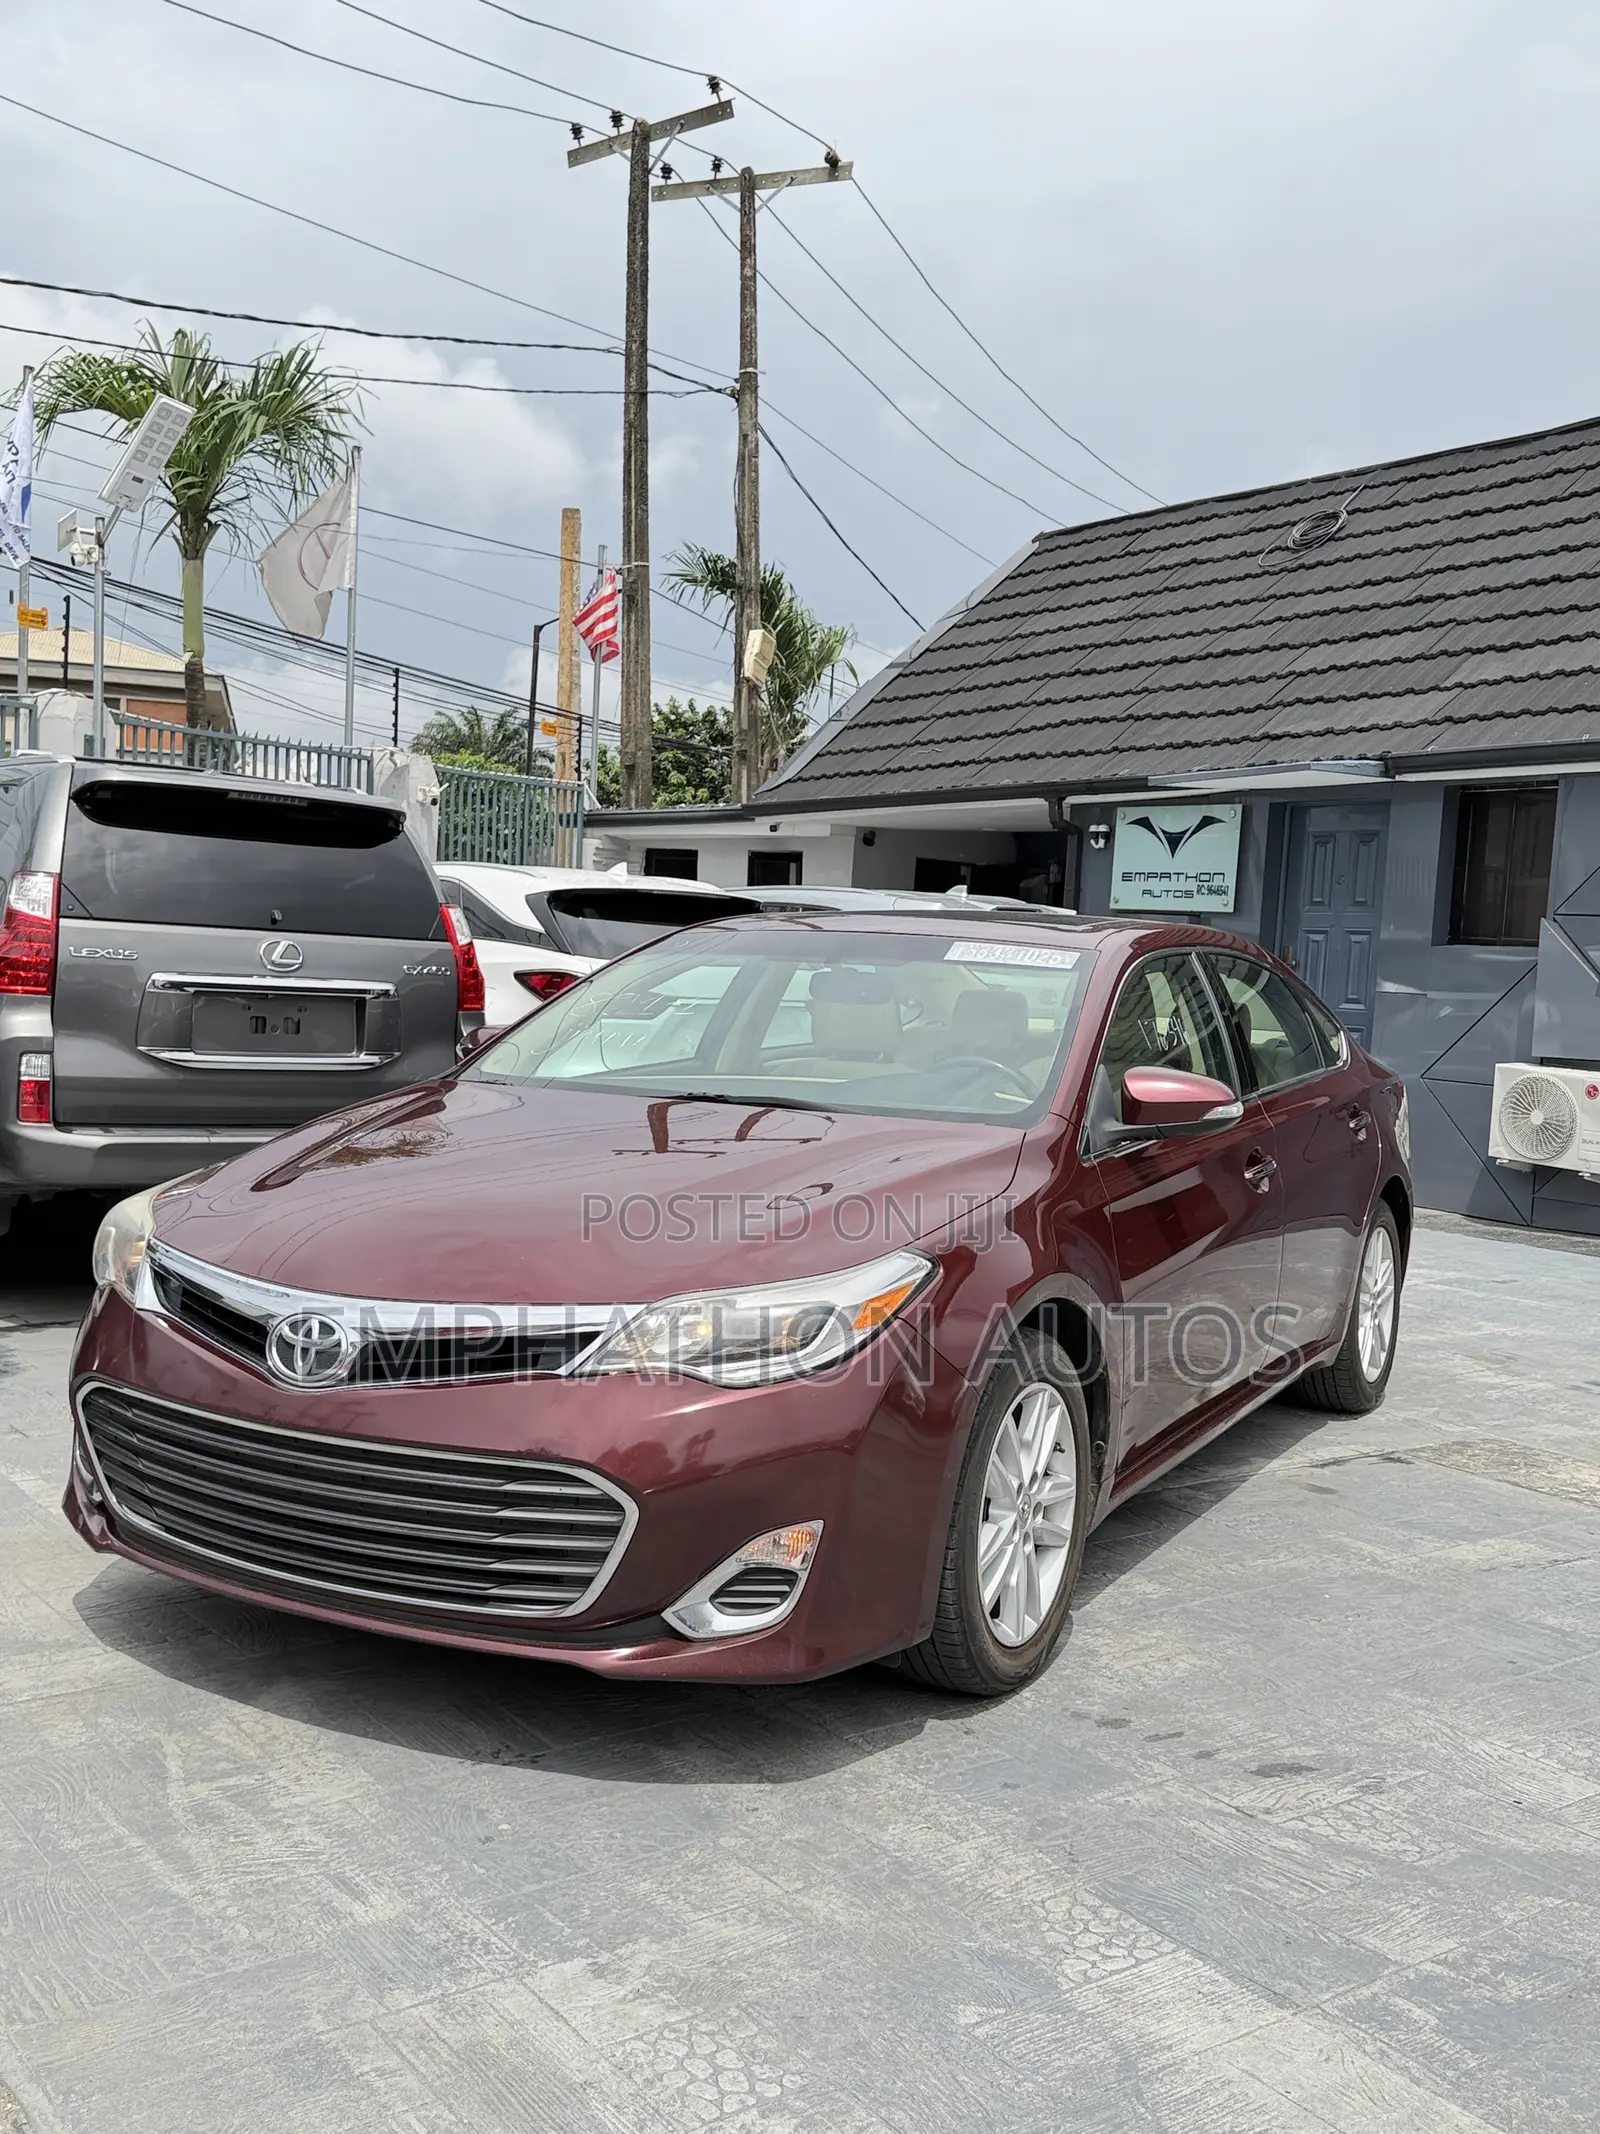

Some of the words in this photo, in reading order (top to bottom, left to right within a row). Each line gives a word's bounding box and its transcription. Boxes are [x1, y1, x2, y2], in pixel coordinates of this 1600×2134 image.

[1121, 872, 1226, 883] EMPATHON
[1141, 889, 1195, 899] AUTOS
[68, 946, 139, 960] LEXUS
